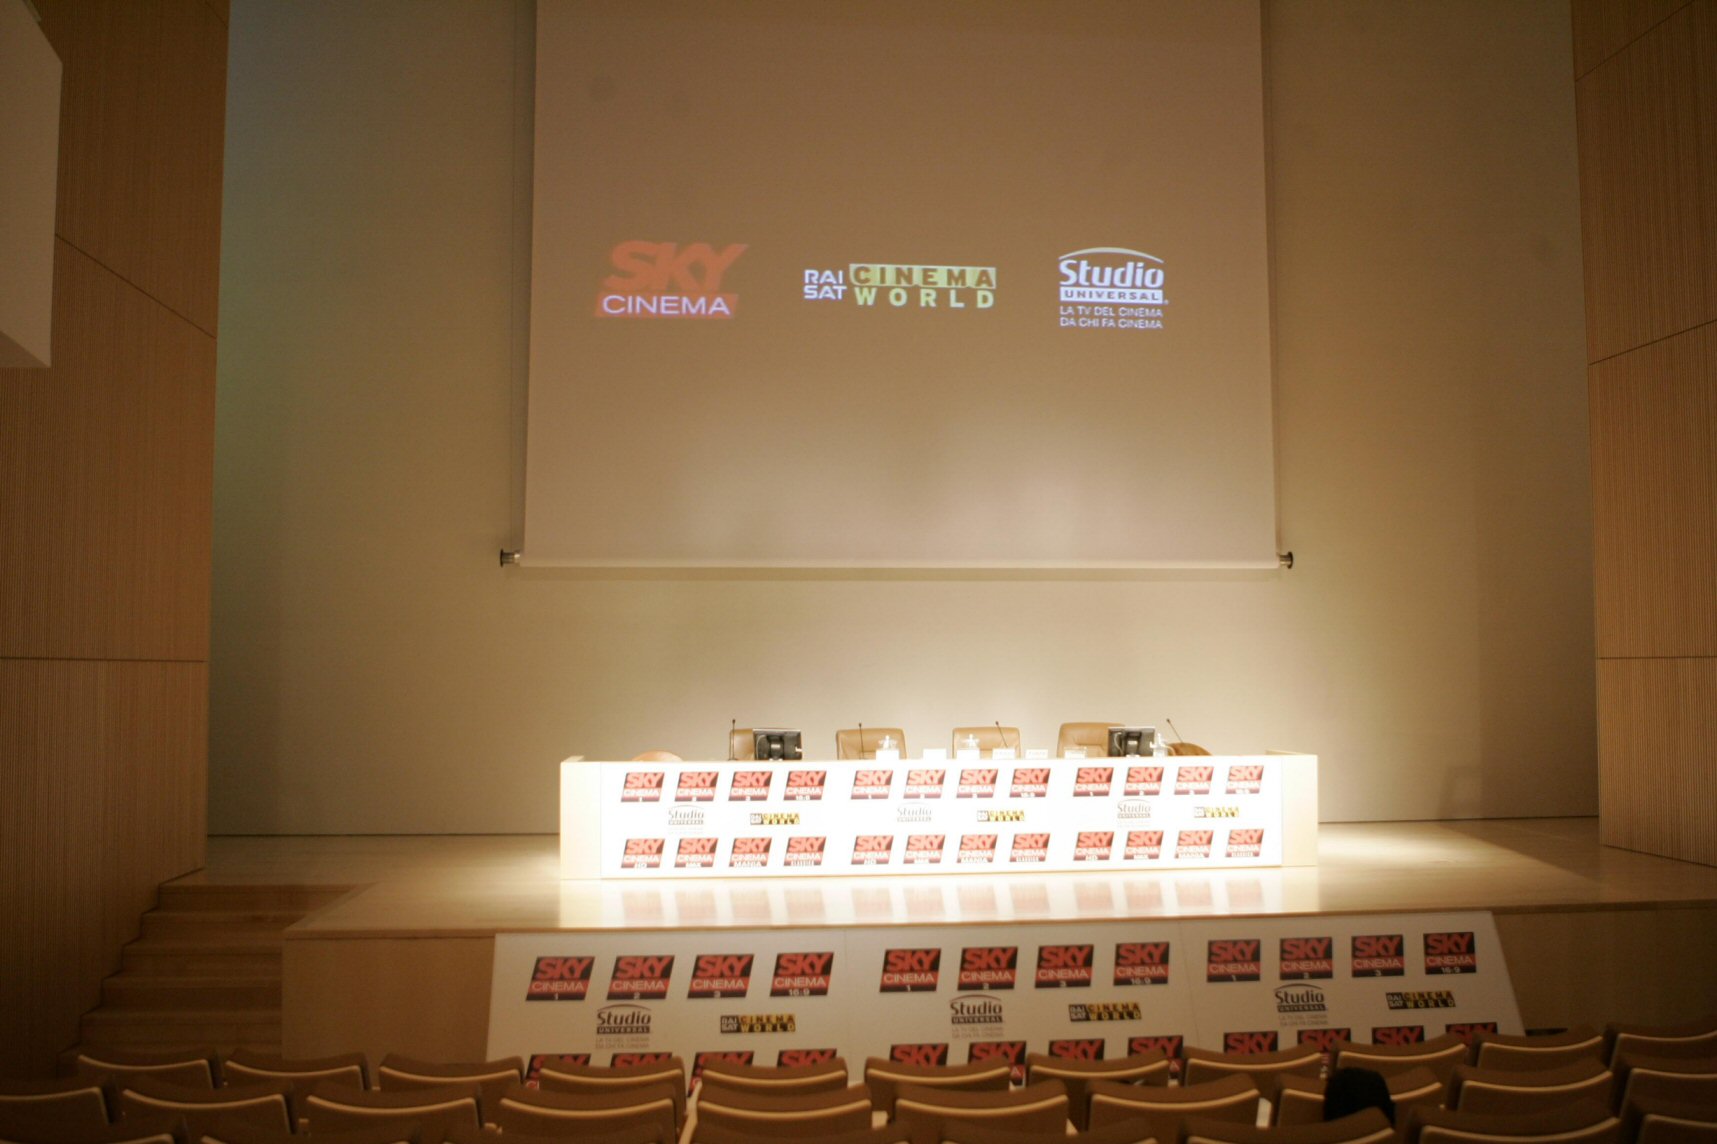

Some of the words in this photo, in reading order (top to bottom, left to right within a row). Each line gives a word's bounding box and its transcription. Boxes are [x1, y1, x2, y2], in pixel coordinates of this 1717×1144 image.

[603, 240, 749, 290] SKY
[804, 269, 843, 284] RAI
[853, 265, 993, 287] CINEMA
[1059, 259, 1164, 288] Studio
[803, 284, 847, 300] SAT
[854, 287, 994, 309] WORLD
[1064, 290, 1159, 301] UNIVERSAL
[602, 295, 730, 315] CINEMA
[1060, 306, 1074, 315] LA
[1077, 306, 1091, 315] TV
[1094, 306, 1115, 316] DEL
[1118, 307, 1163, 318] CINEMA
[1060, 317, 1075, 327] DA
[1079, 317, 1099, 327] CHI
[1102, 318, 1115, 328] FA
[1118, 318, 1163, 329] CINEMA
[626, 774, 663, 788] SKY
[680, 773, 717, 787] SKY
[734, 772, 771, 787] SKY
[789, 772, 825, 786] SKY
[856, 771, 892, 785] SKY
[909, 771, 944, 785] SKY
[961, 770, 997, 784] SKY
[1014, 769, 1049, 784] SKY
[1078, 768, 1112, 783] SKY
[1128, 768, 1162, 782] SKY
[1179, 767, 1212, 781] SKY
[1230, 767, 1262, 781] SKY
[787, 787, 821, 795] CINEMA
[856, 837, 891, 851] SKY
[908, 836, 944, 850] SKY
[961, 835, 996, 849] SKY
[1014, 834, 1048, 848] SKY
[1078, 833, 1112, 847] SKY
[1128, 832, 1162, 846] SKY
[1179, 831, 1212, 845] SKY
[1230, 830, 1262, 844] SKY
[626, 840, 663, 854] SKY
[680, 839, 717, 853] SKY
[734, 838, 770, 853] SKY
[789, 837, 824, 852] SKY
[1211, 941, 1258, 961] SKY
[1283, 938, 1329, 960] SKY
[1354, 936, 1400, 957] SKY
[1426, 933, 1471, 955] SKY
[886, 950, 938, 971] SKY
[963, 948, 1015, 970] SKY
[1040, 945, 1091, 968] SKY
[1118, 943, 1167, 965] SKY
[1427, 955, 1474, 967] CINEMA
[535, 958, 592, 979] SKY
[615, 957, 672, 978] SKY
[696, 955, 751, 977] SKY
[777, 954, 830, 976] SKY
[1209, 963, 1258, 974] CINEMA
[1281, 960, 1330, 972] CINEMA
[1354, 958, 1402, 969] CINEMA
[884, 972, 934, 984] CINEMA
[961, 971, 1012, 982] CINEMA
[1038, 969, 1089, 980] CINEMA
[1116, 966, 1166, 978] CINEMA
[531, 981, 585, 992] CINEMA
[612, 980, 666, 991] CINEMA
[692, 979, 746, 990] CINEMA
[774, 977, 825, 988] CINEMA
[1275, 990, 1324, 1004] Studio
[950, 1001, 1002, 1016] Studio
[597, 1011, 651, 1026] Studio
[740, 1014, 795, 1025] CINEMA
[740, 1023, 795, 1033] WORLD
[1375, 1027, 1422, 1046] SKY
[1225, 1034, 1274, 1054] SKY
[892, 1047, 944, 1066] SKY
[1050, 1042, 1102, 1061] SKY
